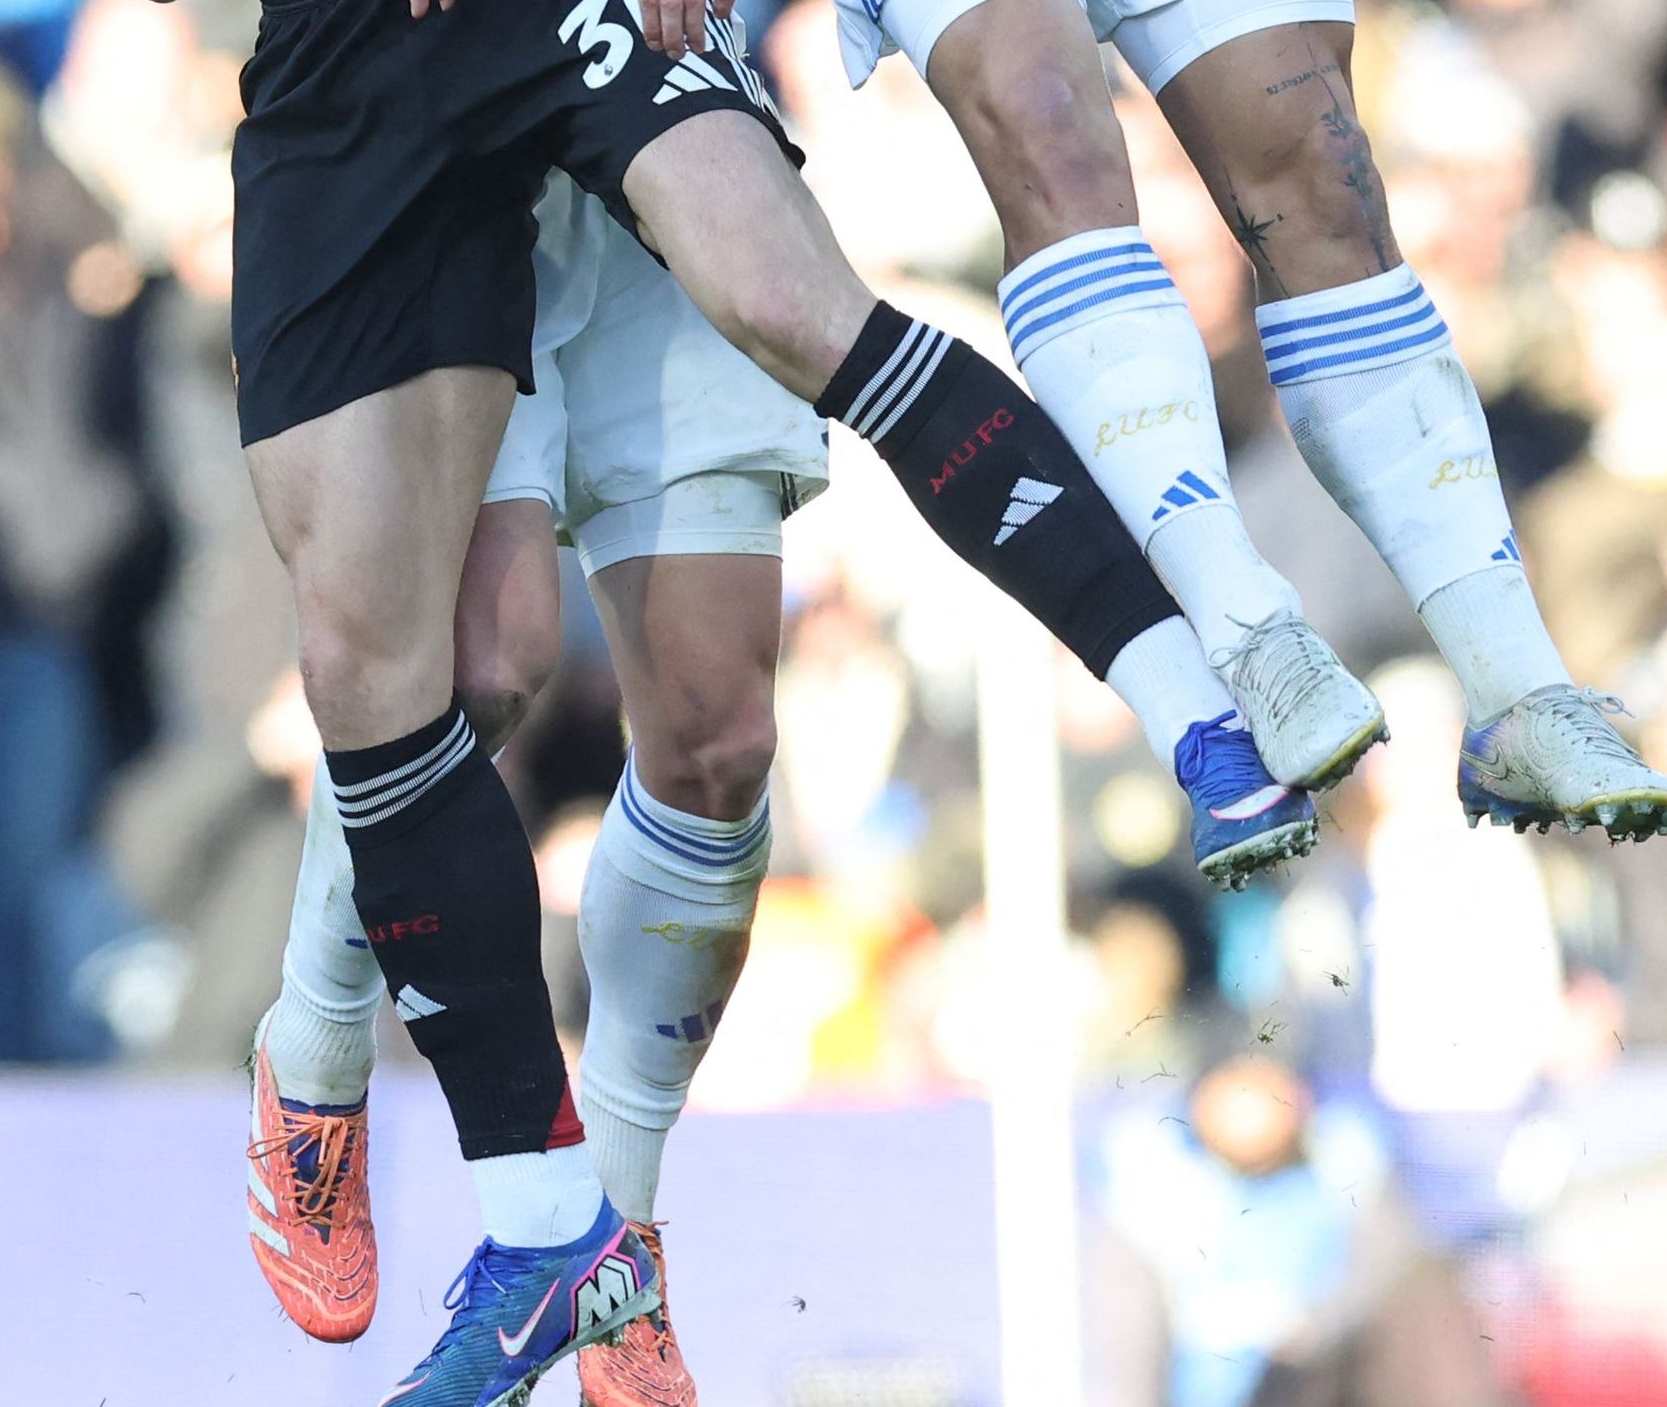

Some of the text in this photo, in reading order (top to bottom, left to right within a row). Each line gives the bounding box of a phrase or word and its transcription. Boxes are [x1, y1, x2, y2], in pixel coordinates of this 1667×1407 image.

[929, 407, 1015, 495] MUFC
[1427, 454, 1499, 490] LU
[366, 914, 441, 944] UFC
